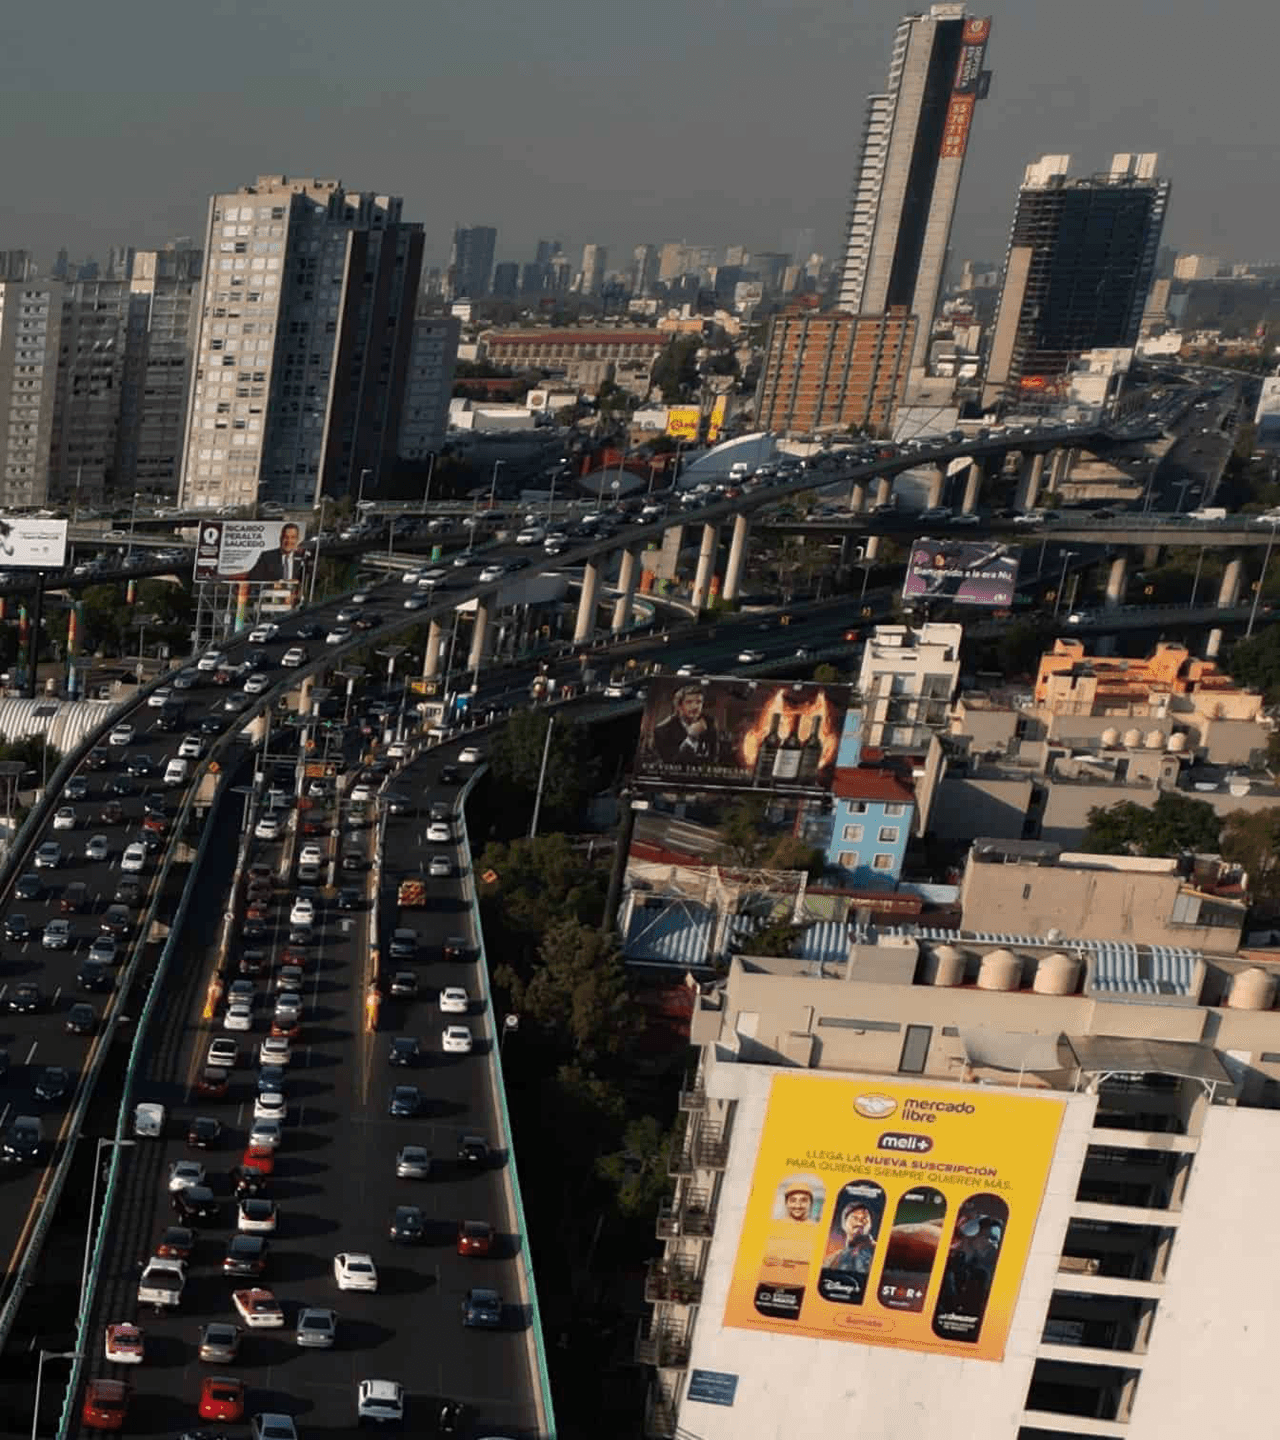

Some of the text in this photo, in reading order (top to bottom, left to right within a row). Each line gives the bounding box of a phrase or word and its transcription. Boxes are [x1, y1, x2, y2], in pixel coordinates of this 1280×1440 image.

[904, 1098, 975, 1114] mercado
[902, 1109, 937, 1123] libre
[882, 1136, 929, 1151] meli+
[786, 1158, 816, 1169] PARA
[818, 1160, 871, 1175] QUIENES
[874, 1166, 924, 1181] SIEMPRE
[927, 1173, 982, 1187] QUIEREN
[846, 1153, 861, 1162] LA
[864, 1155, 908, 1168] NUEVA
[911, 1160, 998, 1177] SUSCRIPCIÓN
